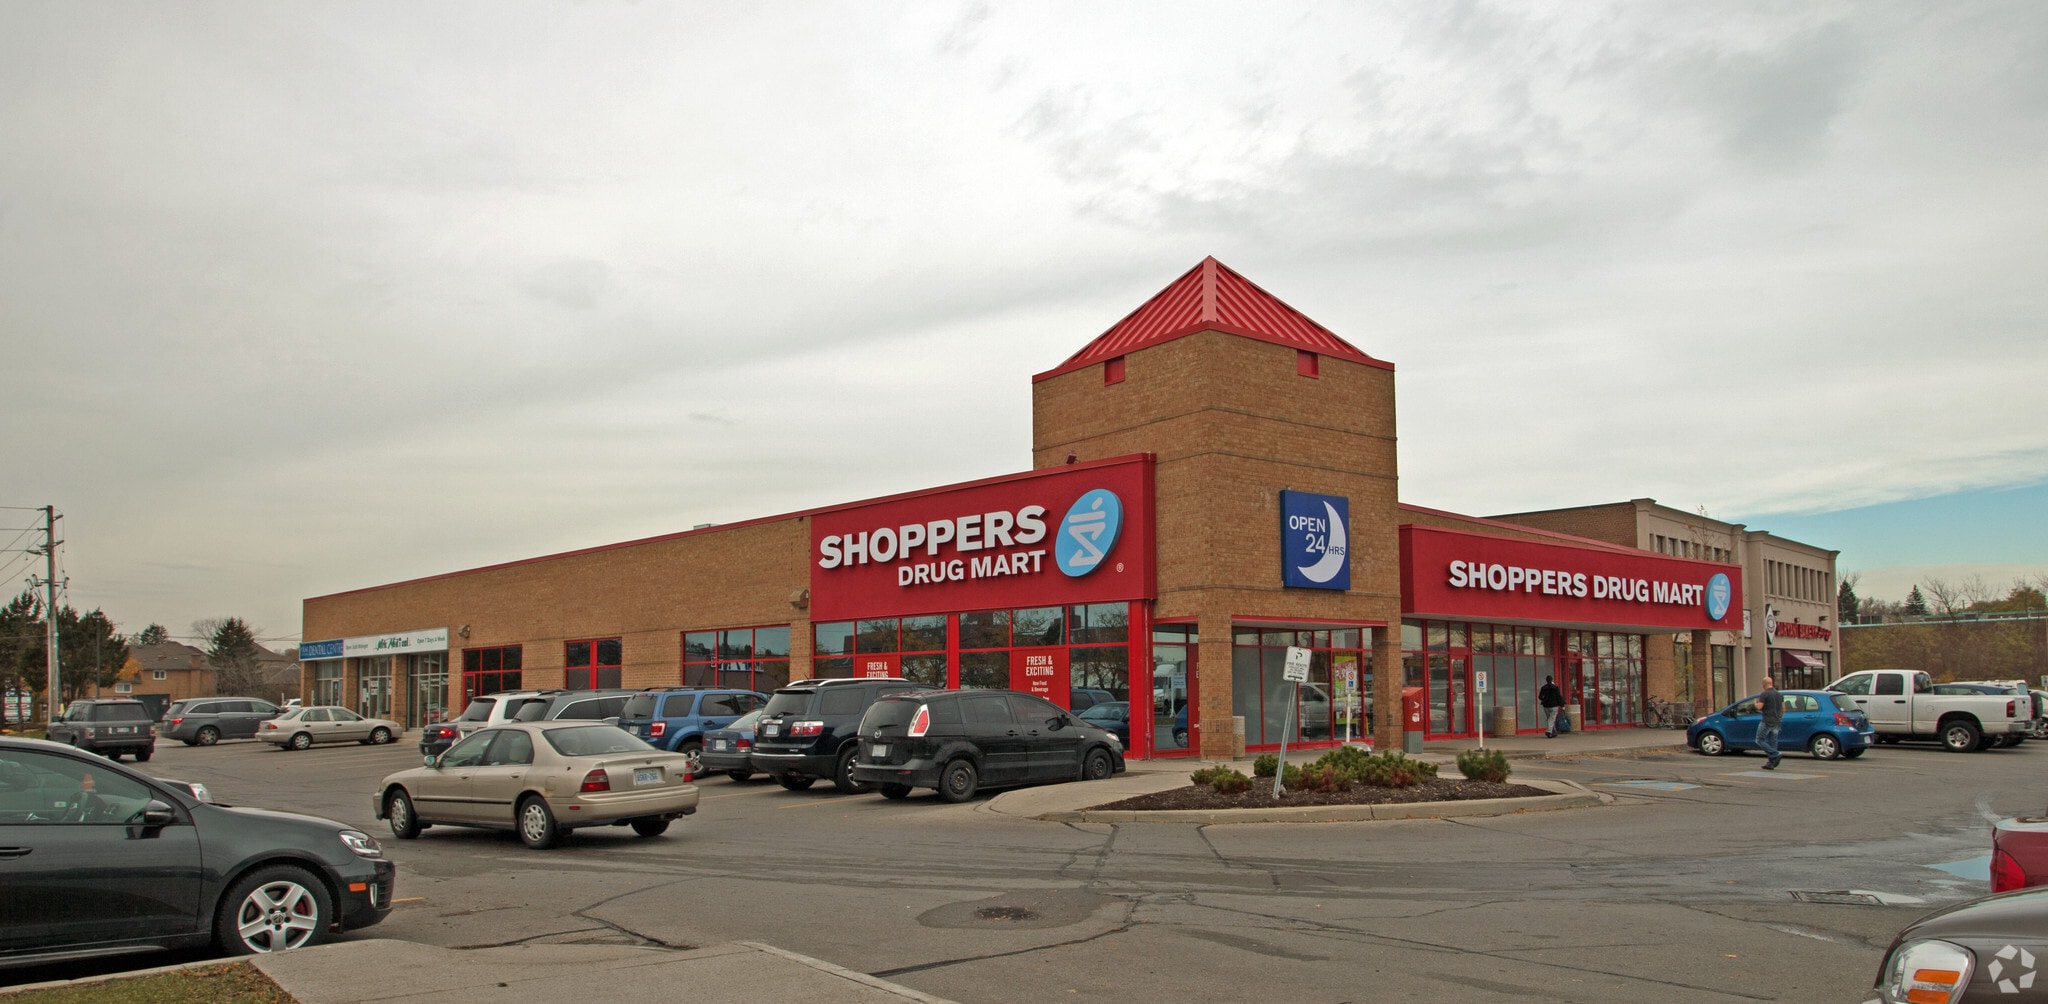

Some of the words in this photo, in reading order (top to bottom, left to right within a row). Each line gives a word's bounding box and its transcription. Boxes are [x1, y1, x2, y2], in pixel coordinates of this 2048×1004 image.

[1289, 515, 1326, 533] OPEN
[818, 505, 1047, 569] SHOPPERS
[1305, 533, 1326, 554] 24
[1328, 545, 1345, 556] HRS
[898, 559, 964, 586] DRUG
[971, 550, 1046, 578] MART
[1449, 560, 1588, 598] SHOPPERS
[1593, 575, 1649, 603] DRUG
[1653, 580, 1704, 606] MART
[867, 661, 883, 671] FRESH
[1025, 665, 1054, 676] EXCITING
[1026, 655, 1047, 666] FRESH
[1048, 655, 1053, 665] &
